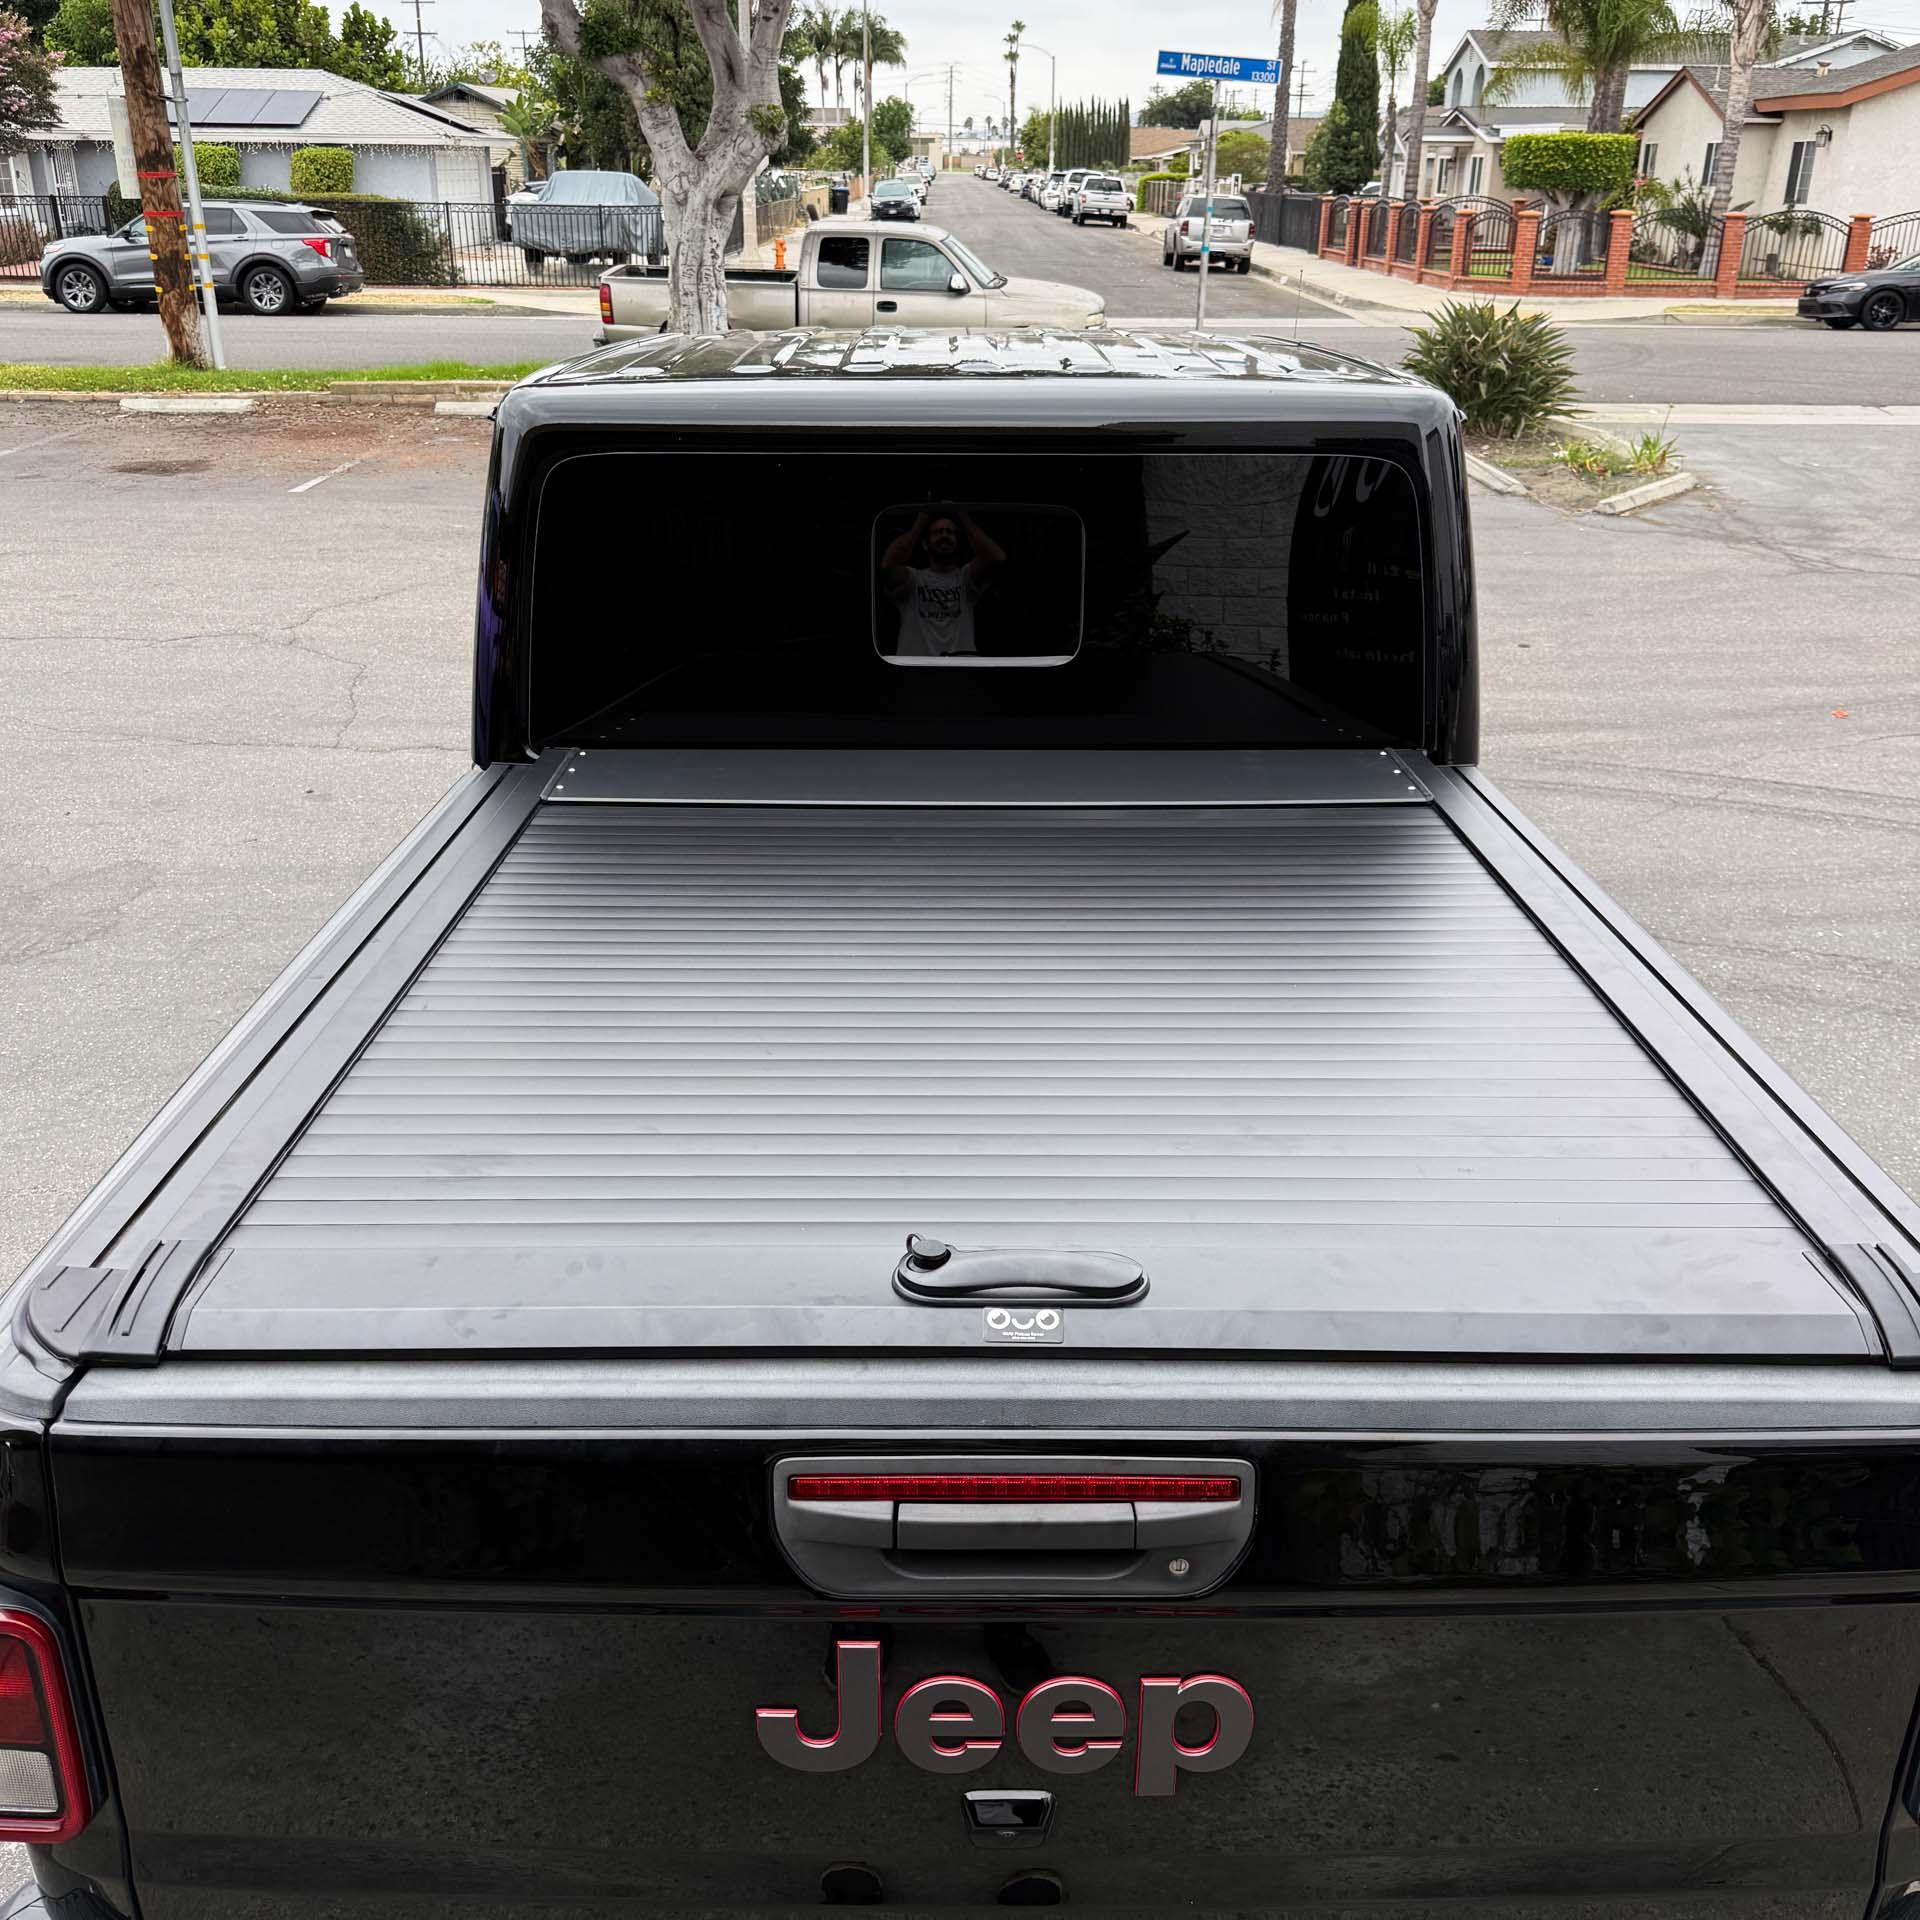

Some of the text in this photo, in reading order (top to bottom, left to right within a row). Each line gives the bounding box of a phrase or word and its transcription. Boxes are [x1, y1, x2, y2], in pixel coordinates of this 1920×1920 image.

[1181, 53, 1240, 75] Mapledale
[1251, 71, 1276, 83] 13300
[755, 1640, 1255, 1798] Jeep
